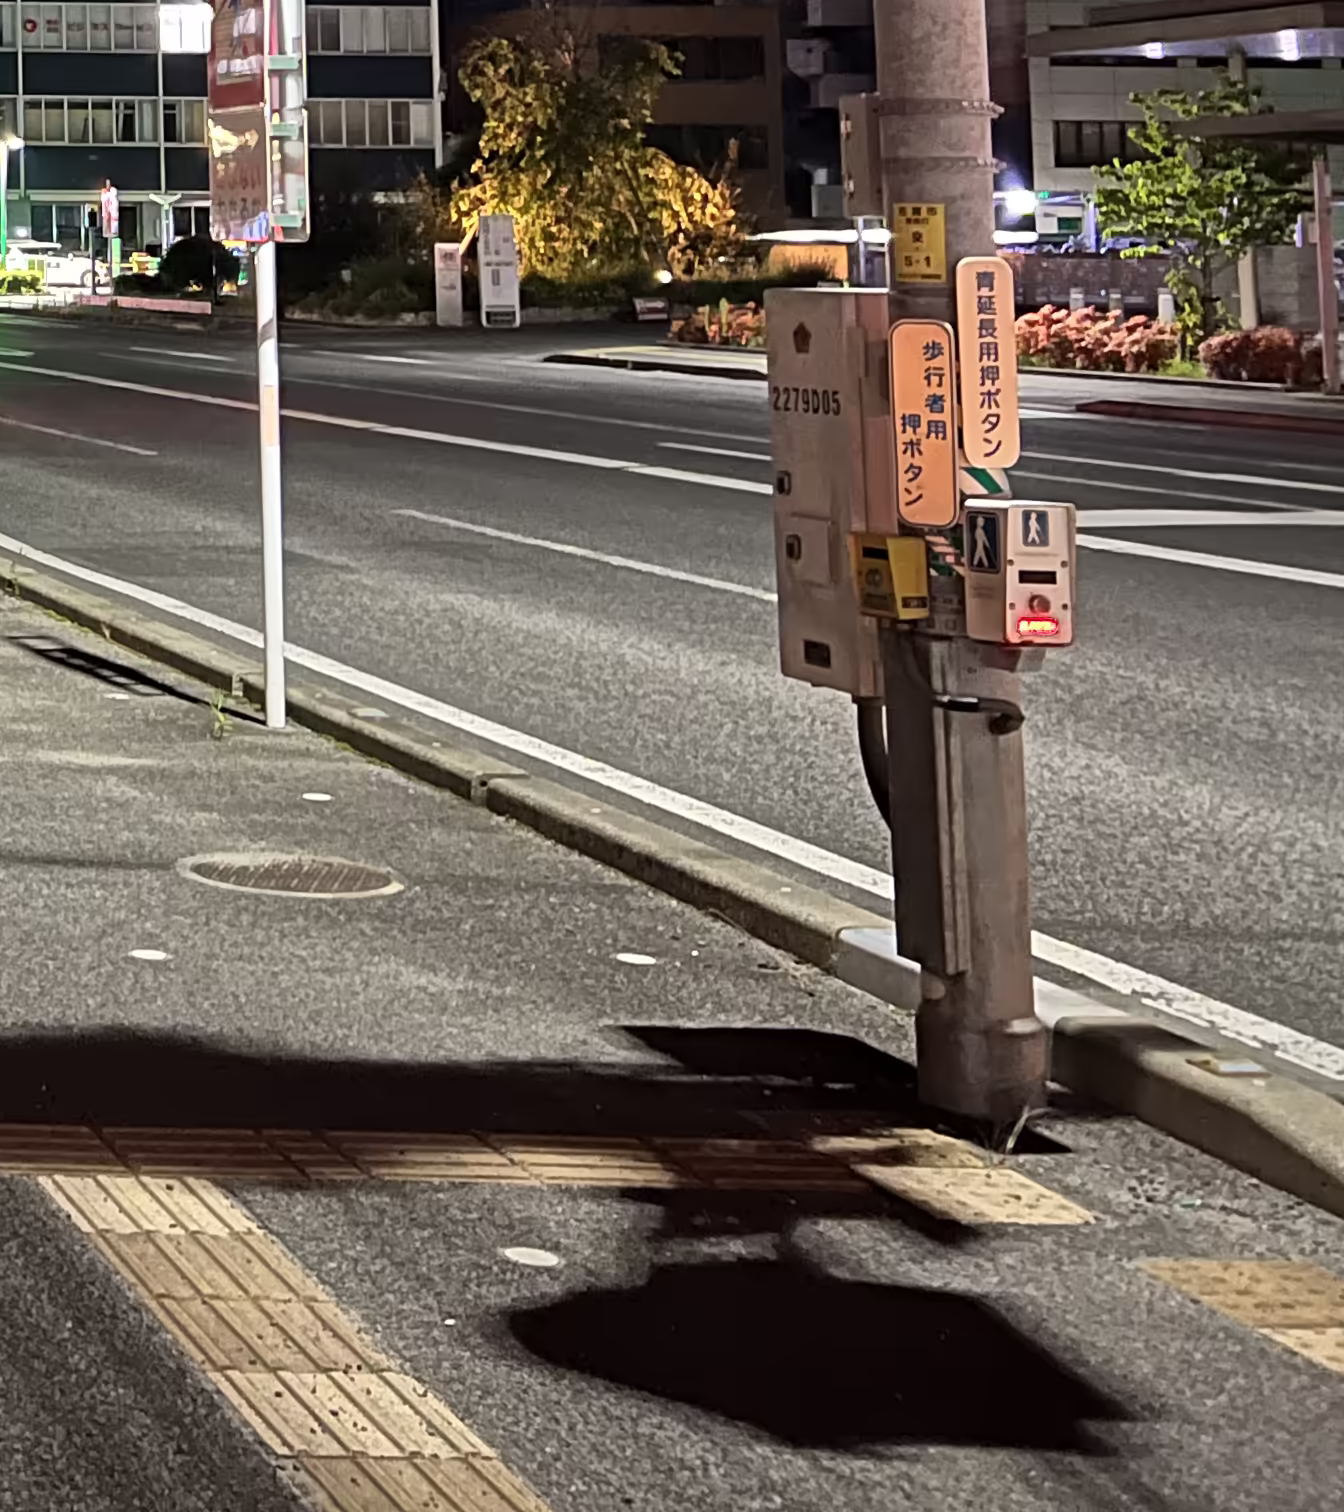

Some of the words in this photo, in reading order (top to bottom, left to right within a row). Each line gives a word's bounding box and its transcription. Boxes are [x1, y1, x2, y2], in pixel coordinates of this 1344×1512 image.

[922, 339, 948, 441] 歩行者用
[975, 270, 1002, 458] 青延長用押ボタン
[899, 413, 924, 507] 押ボタン
